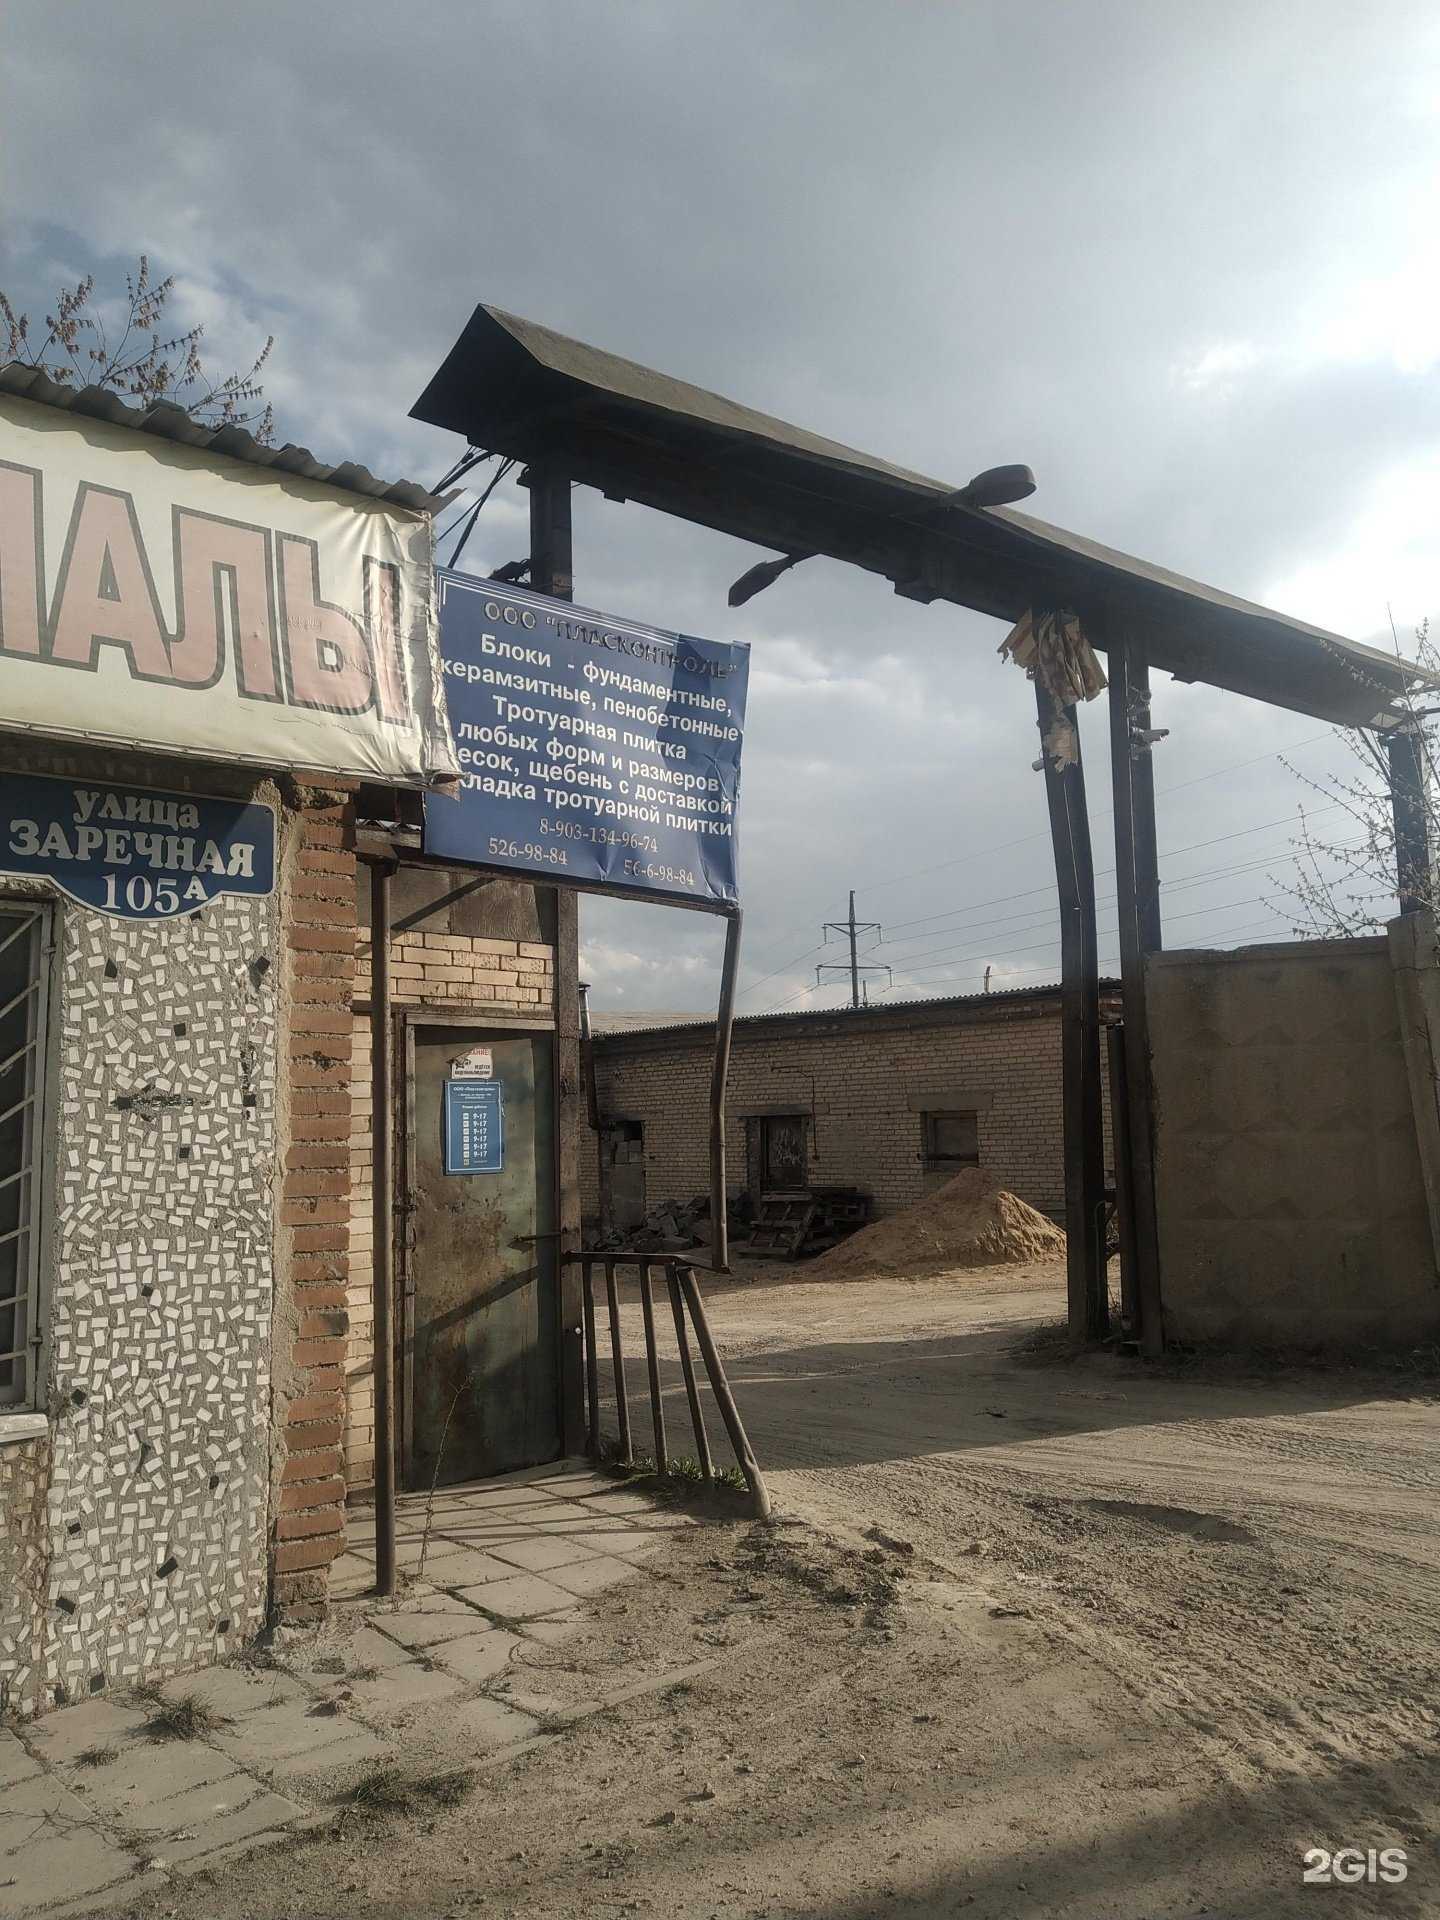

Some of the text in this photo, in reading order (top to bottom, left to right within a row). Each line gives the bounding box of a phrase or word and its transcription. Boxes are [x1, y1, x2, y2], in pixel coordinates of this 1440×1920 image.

[484, 601, 537, 631] ООО
[441, 657, 739, 742] керамзитные, пенобетонные
[480, 633, 552, 669] Блоки
[583, 659, 733, 717] фундаментные,
[458, 722, 719, 793] любых форм и размеров
[492, 695, 687, 761] Тротуарная плитка
[458, 747, 733, 816] есок, щебень с доставкой
[543, 784, 660, 825] тротуарной
[665, 811, 733, 837] плитки
[8, 818, 256, 878] ЗАРЕЧНАЯ
[488, 837, 569, 867] 526-98-84
[539, 817, 659, 854] 8-903-134-96-74
[101, 872, 209, 914] 105А
